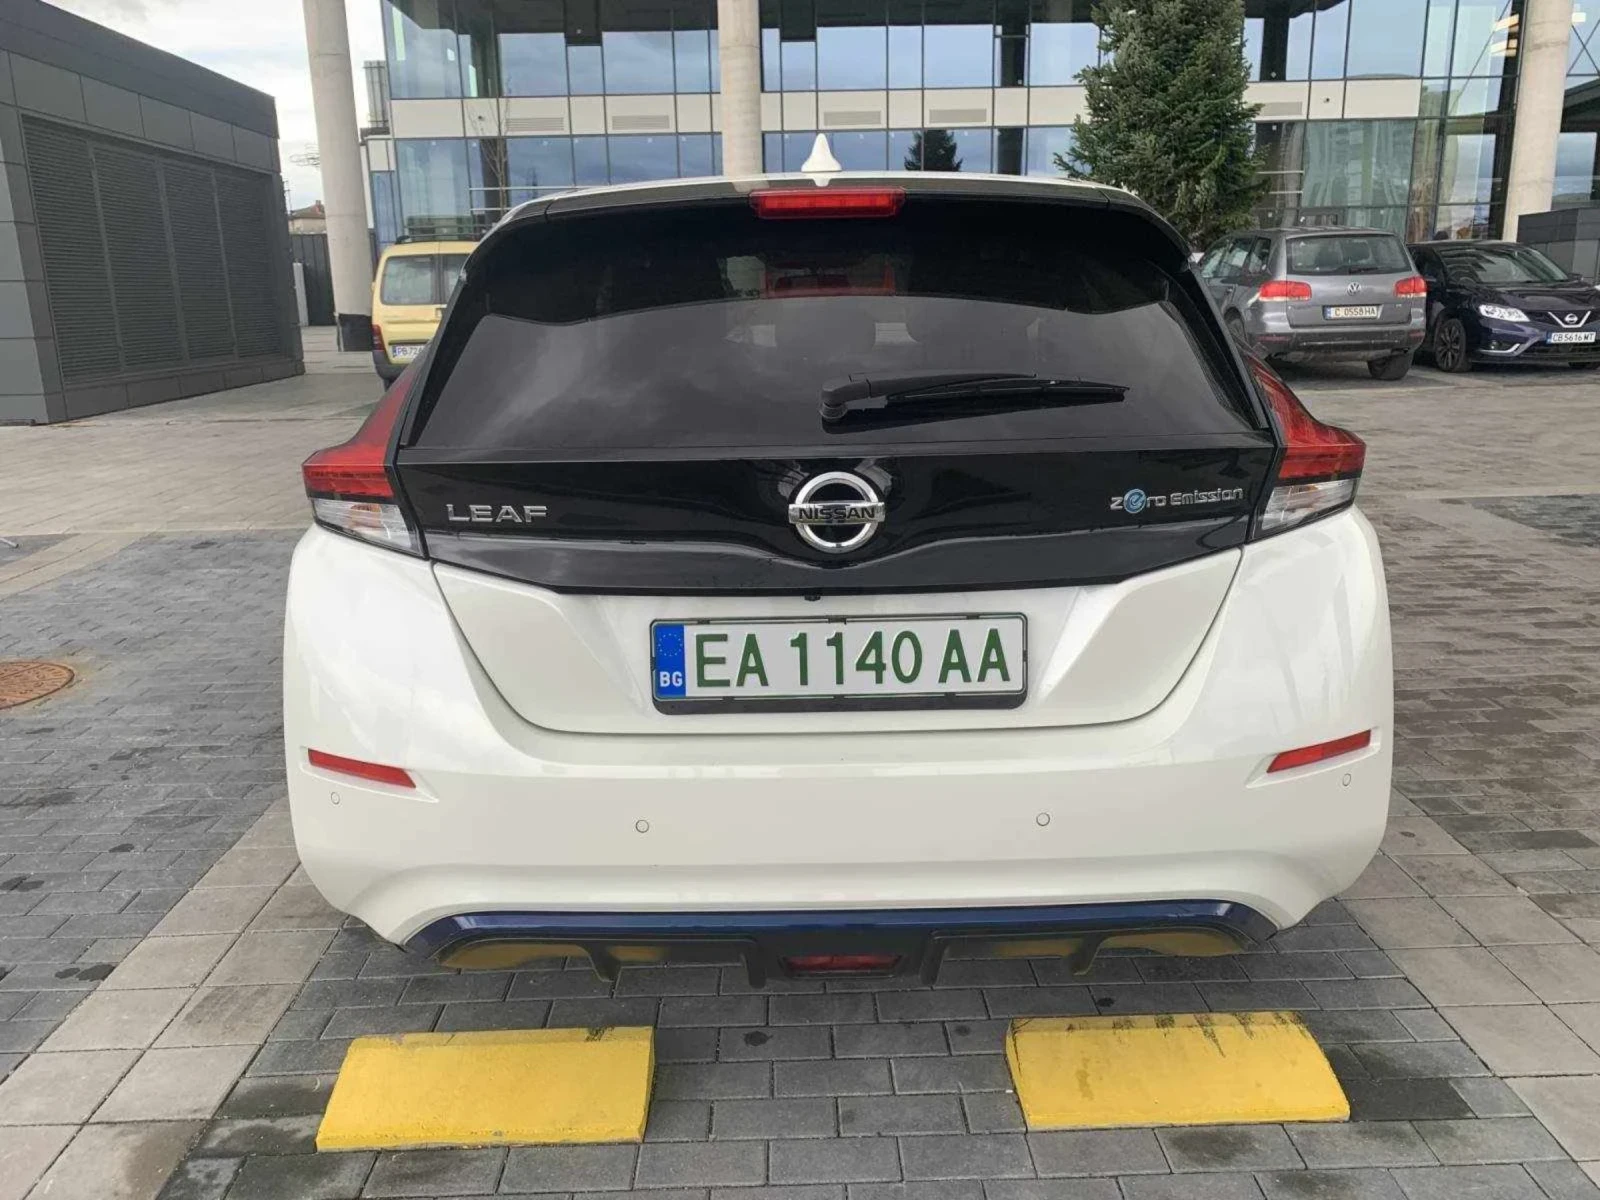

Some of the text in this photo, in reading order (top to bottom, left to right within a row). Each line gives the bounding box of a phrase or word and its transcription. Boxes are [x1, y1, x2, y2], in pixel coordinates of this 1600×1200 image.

[1334, 308, 1341, 316] C
[1552, 333, 1563, 342] CB
[1564, 333, 1583, 342] 5616
[1170, 487, 1244, 506] Emission
[446, 503, 548, 523] LEAF
[799, 507, 875, 520] NISSAN
[695, 628, 1011, 688] EA 1140 AA
[659, 671, 683, 688] BG
